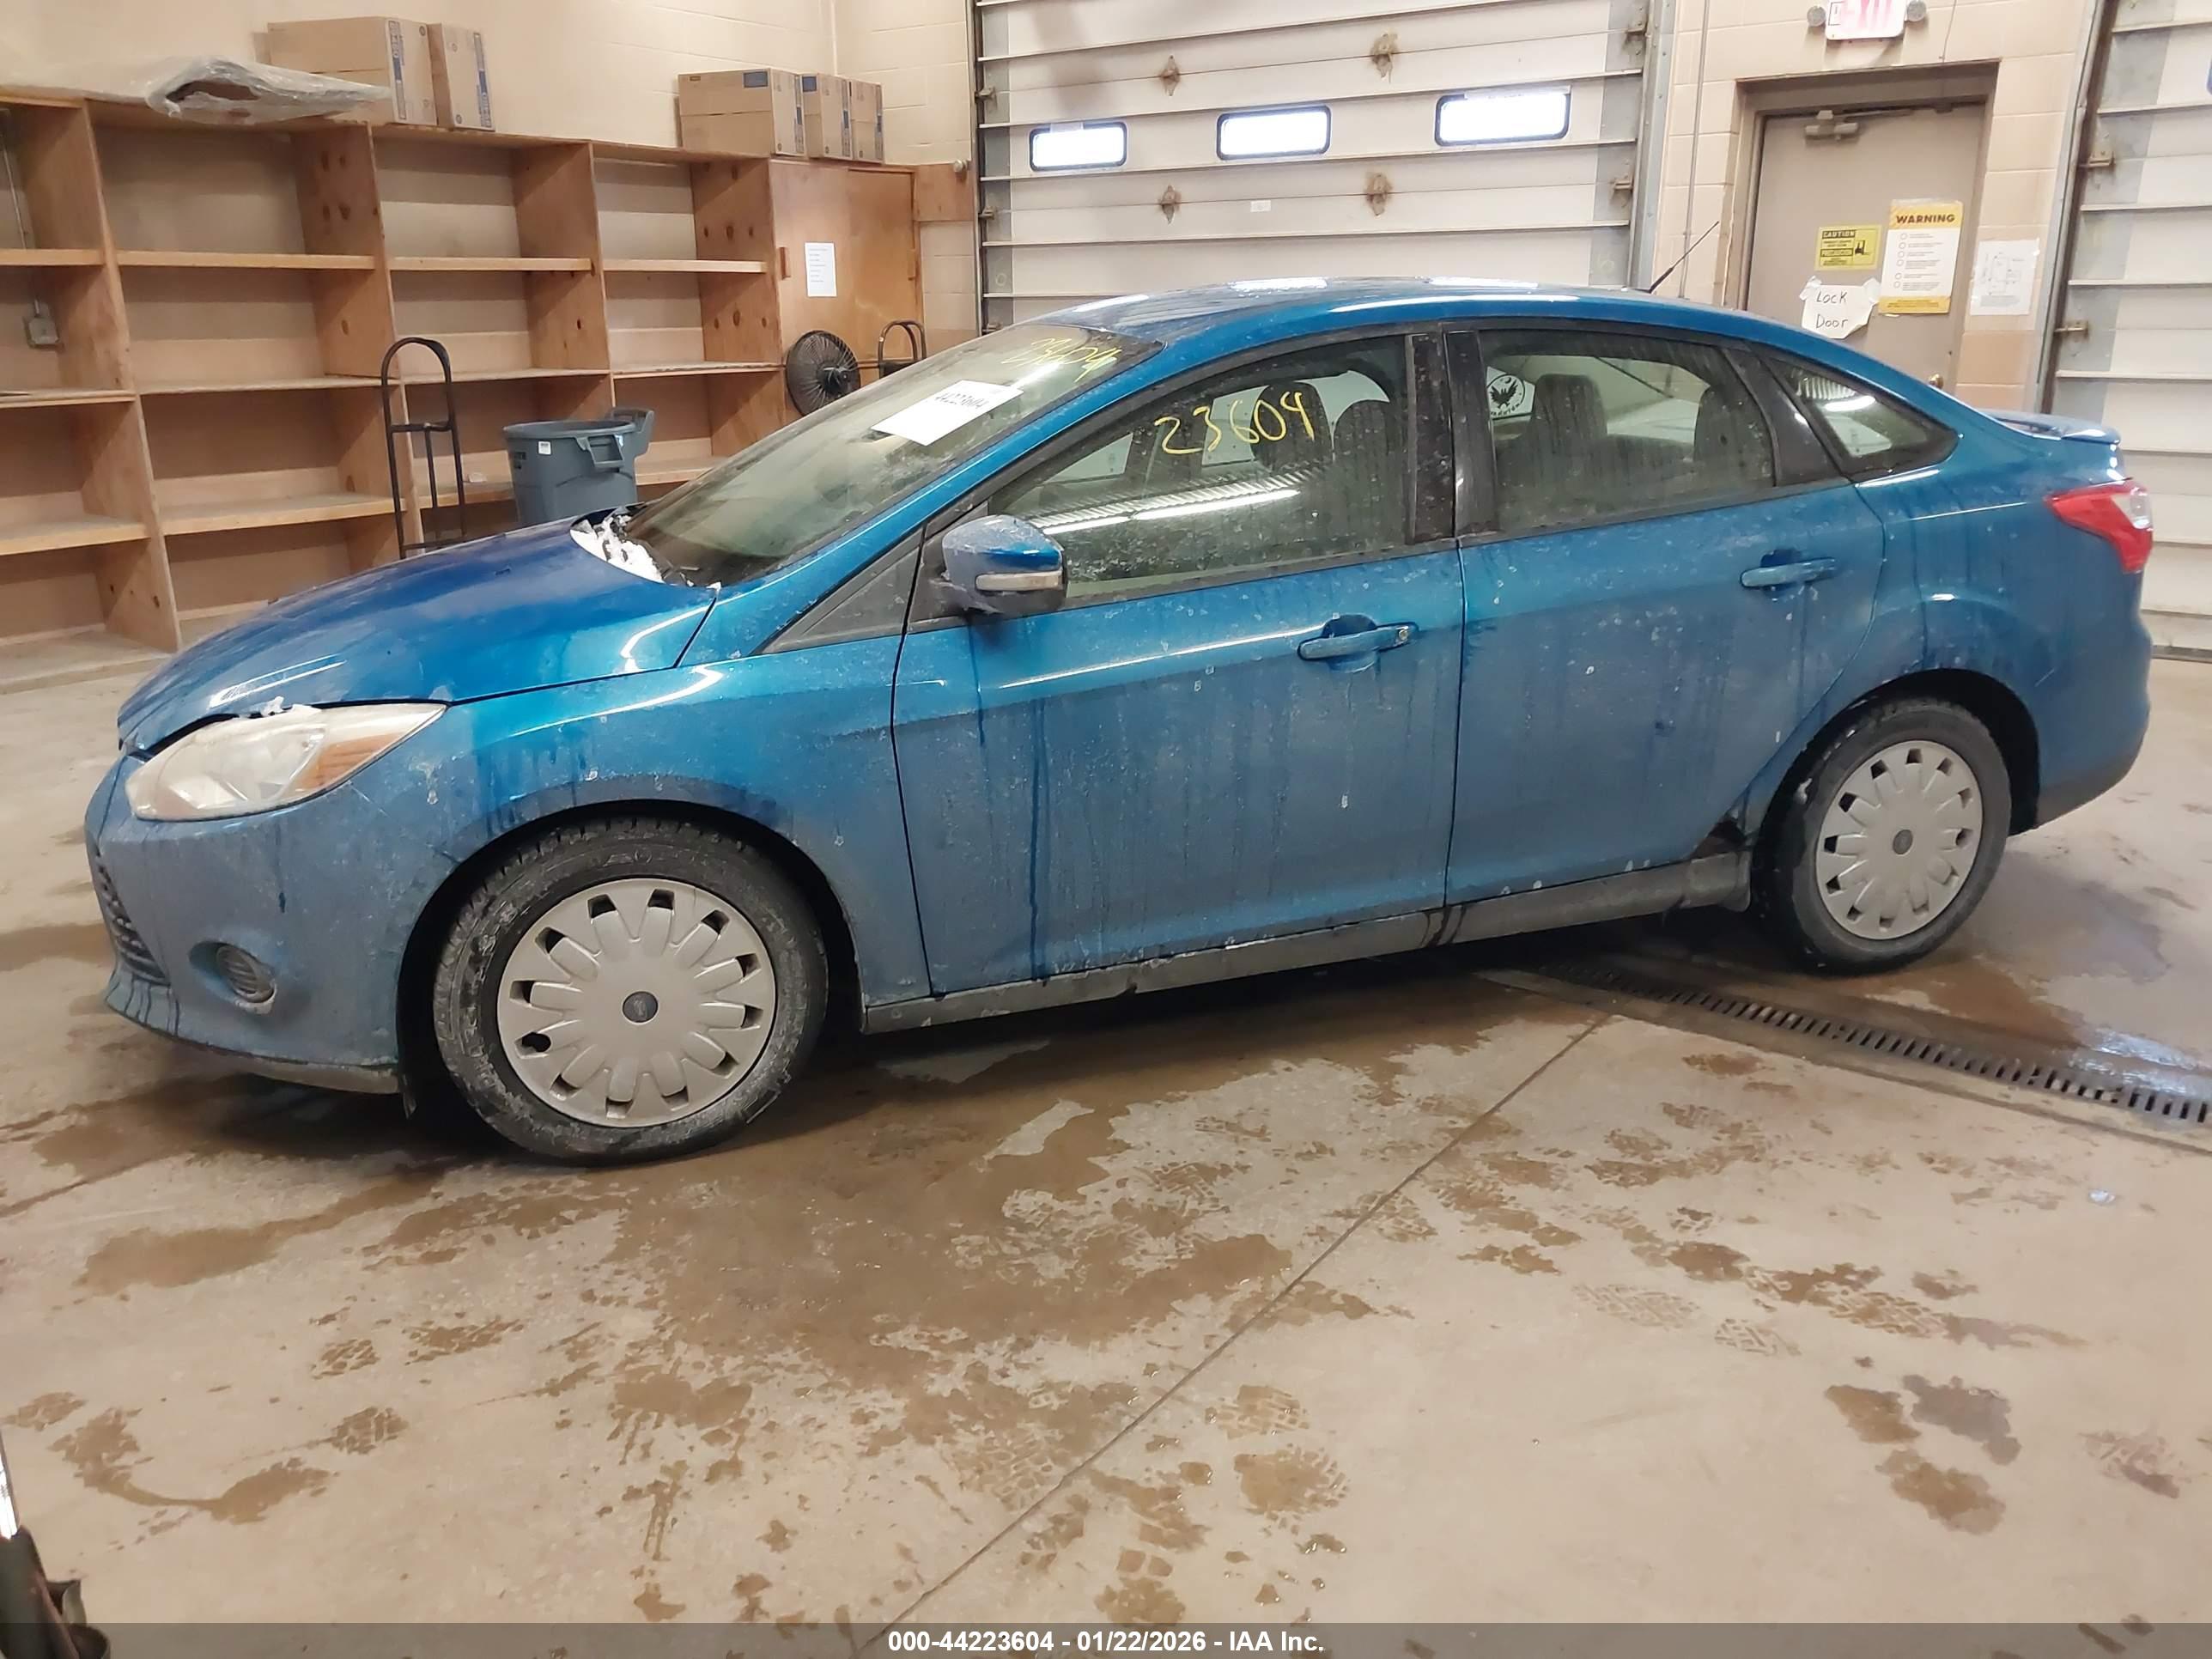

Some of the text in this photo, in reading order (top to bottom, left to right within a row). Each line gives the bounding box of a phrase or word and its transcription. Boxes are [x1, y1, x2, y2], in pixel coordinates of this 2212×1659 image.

[1896, 214, 1955, 224] WARNING
[1815, 313, 1849, 329] Door
[1154, 391, 1316, 454] 23604
